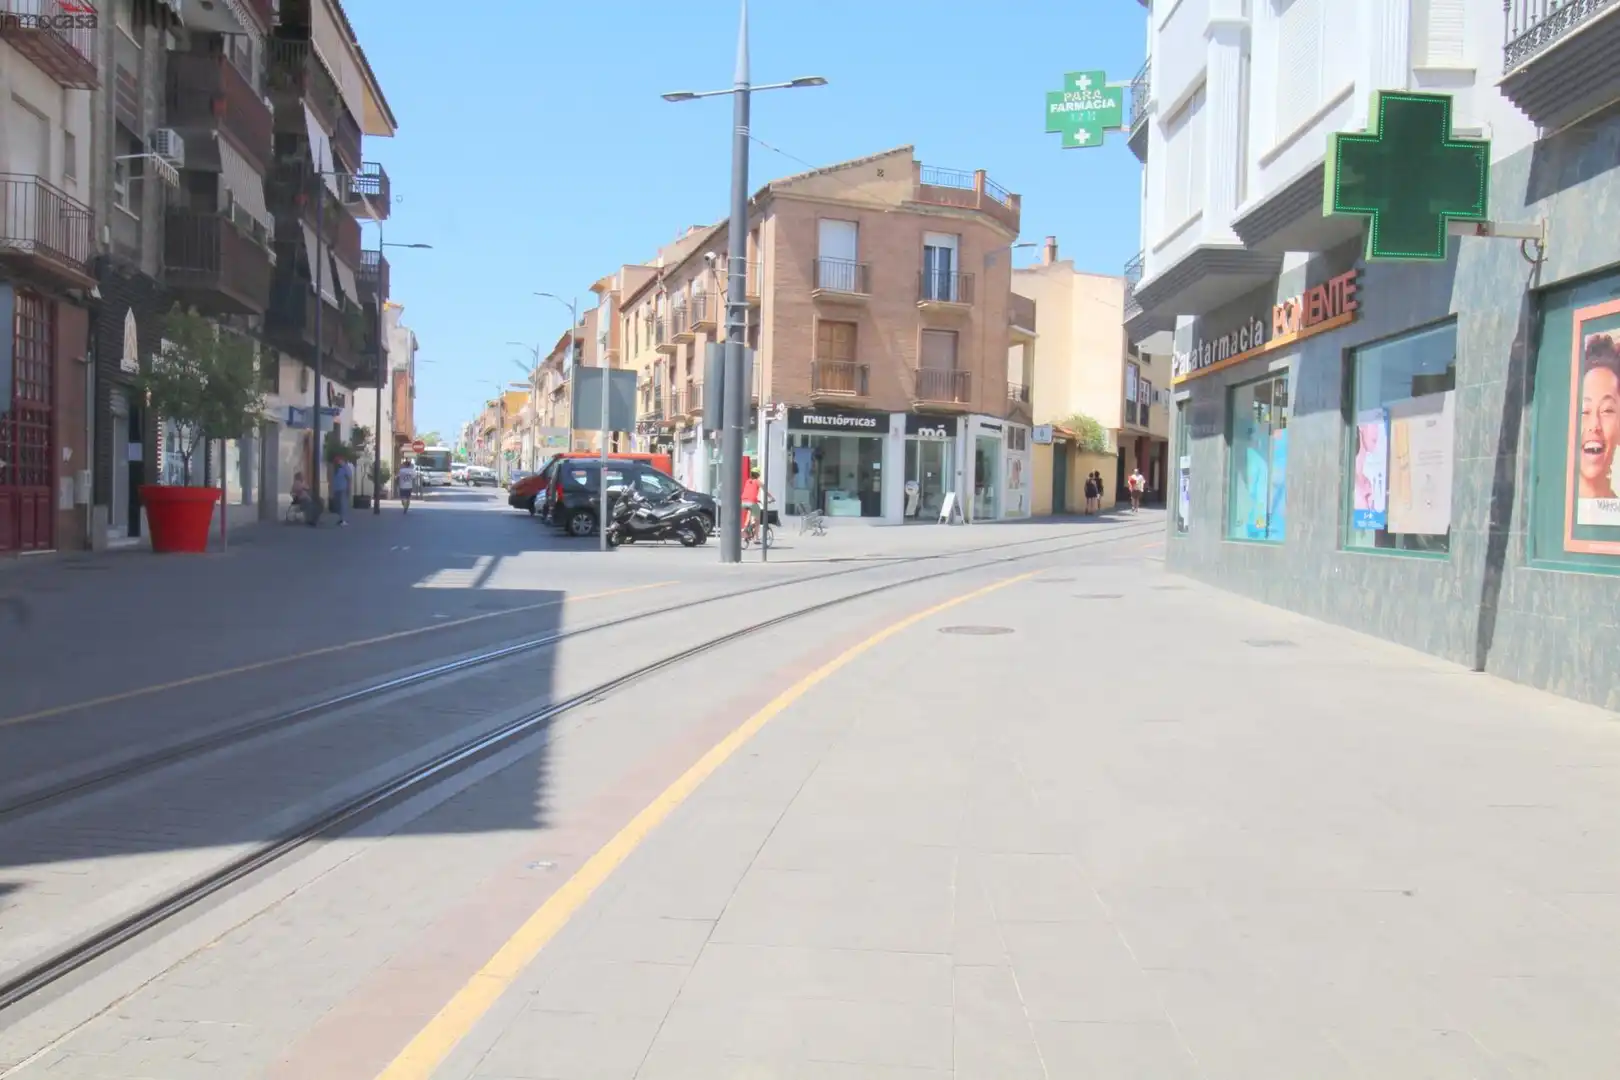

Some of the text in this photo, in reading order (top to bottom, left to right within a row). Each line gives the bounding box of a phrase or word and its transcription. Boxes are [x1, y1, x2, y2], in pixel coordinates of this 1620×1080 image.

[1063, 88, 1102, 102] PARA
[1050, 98, 1116, 113] FARMACIA
[1171, 315, 1264, 378] Parafarmacia
